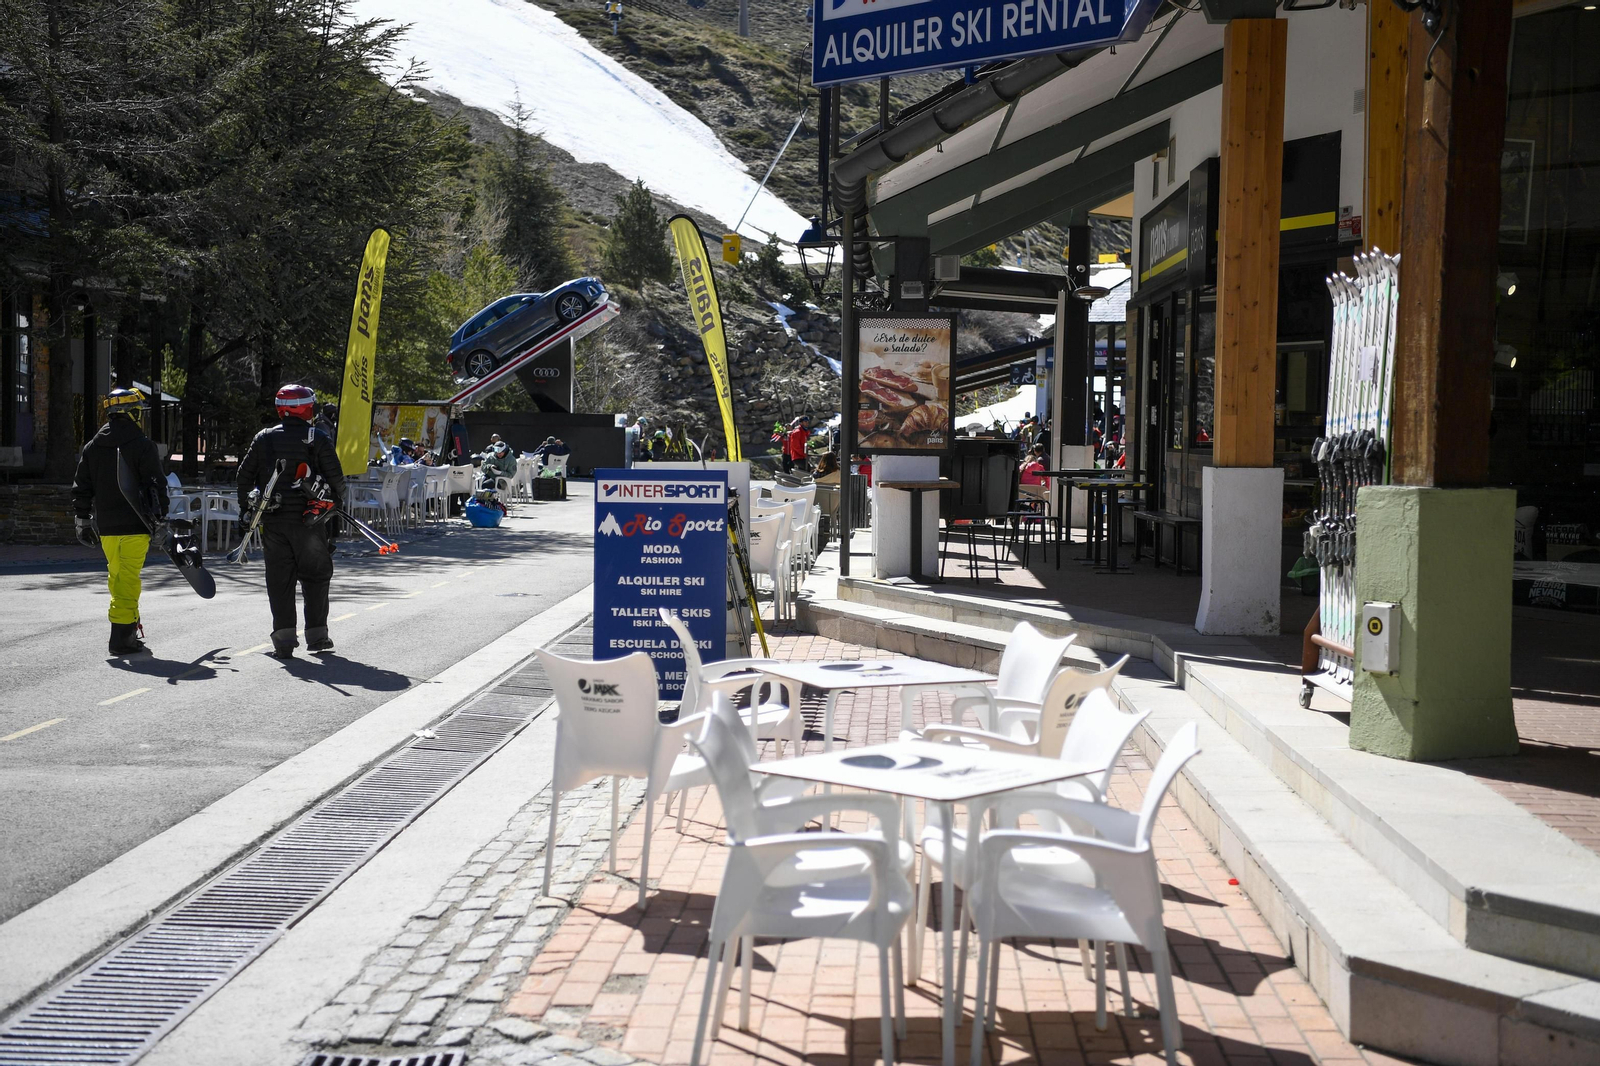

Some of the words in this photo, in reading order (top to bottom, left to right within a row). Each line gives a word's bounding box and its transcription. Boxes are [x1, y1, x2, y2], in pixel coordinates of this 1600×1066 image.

[821, 15, 943, 68] ALQUILER
[950, 7, 991, 48] SKI
[1002, 0, 1112, 40] RENTAL
[1149, 218, 1168, 278] pans
[357, 266, 374, 339] pans
[898, 333, 910, 343] de
[911, 333, 937, 343] dulce
[361, 355, 370, 404] pans
[927, 437, 944, 445] pans
[619, 484, 721, 499] INTERSPORT
[622, 513, 662, 537] Rio
[668, 513, 725, 539] Sport
[643, 545, 680, 554] MODA
[617, 576, 680, 586] ALQUILER
[683, 577, 705, 586] SKI
[1532, 579, 1566, 591] SIERRA
[640, 588, 657, 596] SKI
[659, 588, 682, 596] HIRE
[1528, 587, 1566, 602] NEVADA
[611, 607, 657, 617] TALLER
[681, 608, 711, 618] SKIS
[655, 620, 689, 628] RER
[610, 639, 667, 649] ESCUELA
